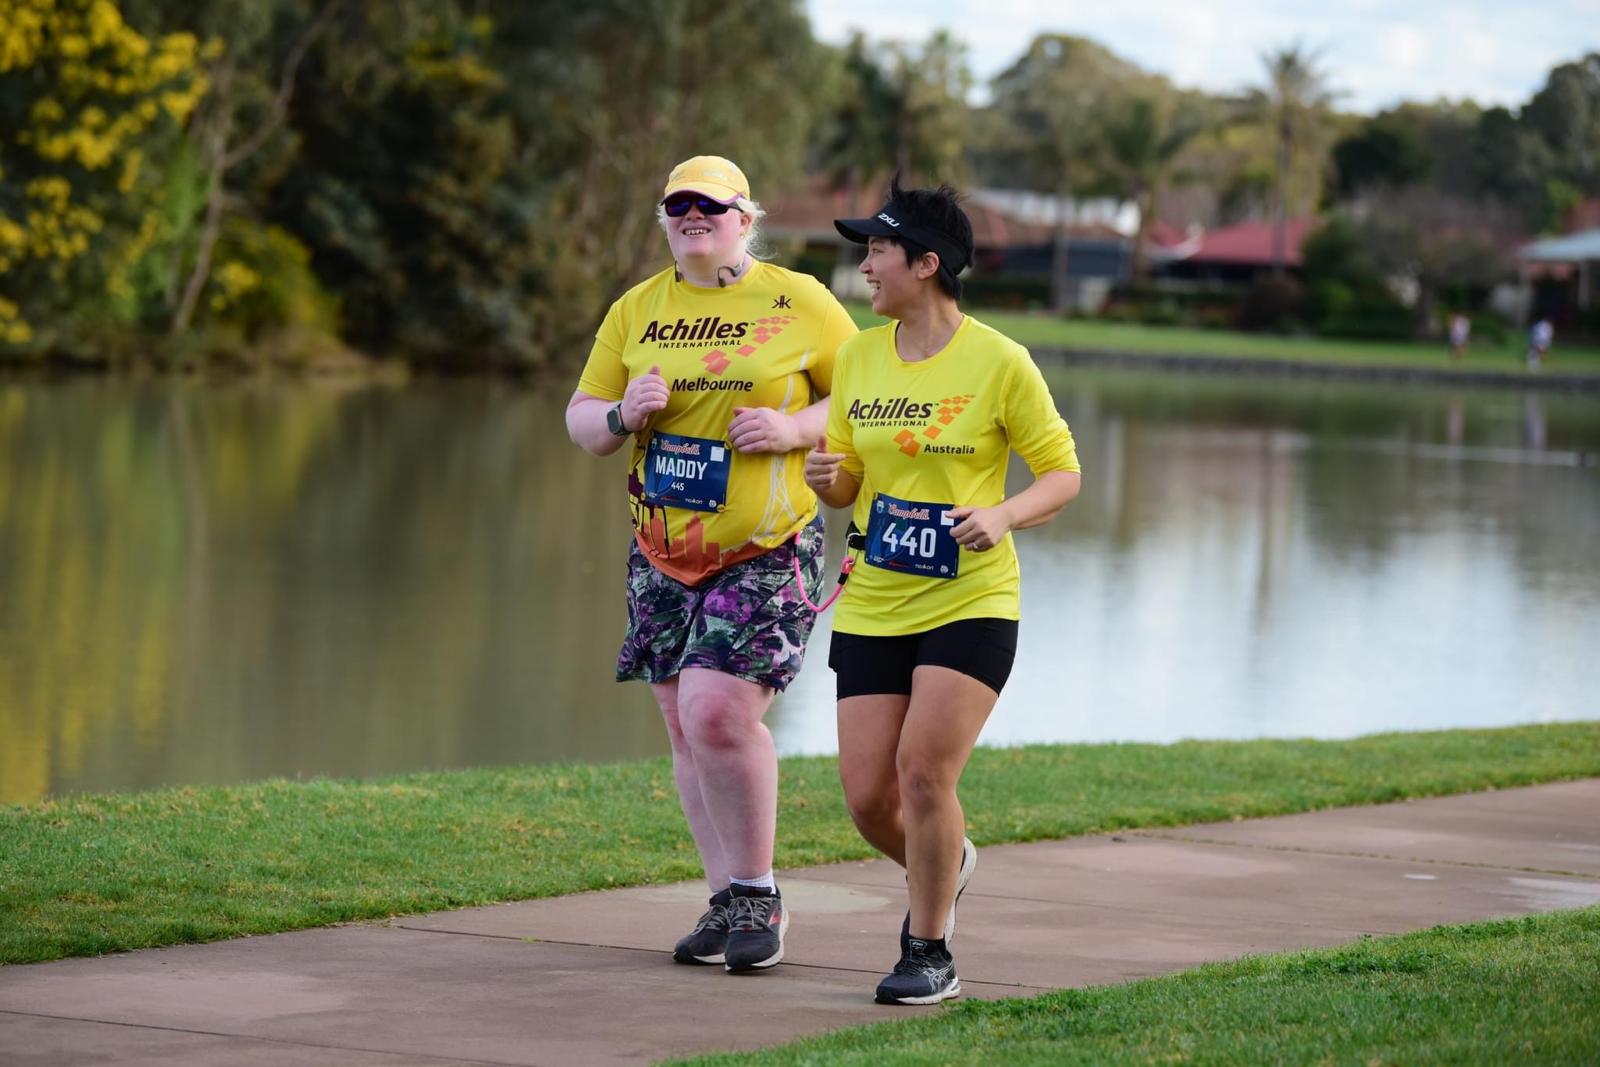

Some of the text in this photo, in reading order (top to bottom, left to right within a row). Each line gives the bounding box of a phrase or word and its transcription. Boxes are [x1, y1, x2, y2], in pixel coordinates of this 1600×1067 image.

[878, 212, 900, 227] 2XU
[639, 317, 748, 344] Achilles
[658, 340, 742, 349] INTERNATIONAL
[672, 378, 753, 392] Melbourne
[847, 397, 933, 420] Achilles
[859, 420, 928, 428] INTERNATIONAL
[924, 444, 975, 454] Australia
[655, 455, 708, 480] MADDY
[671, 482, 685, 491] 445
[882, 522, 937, 558] 440
